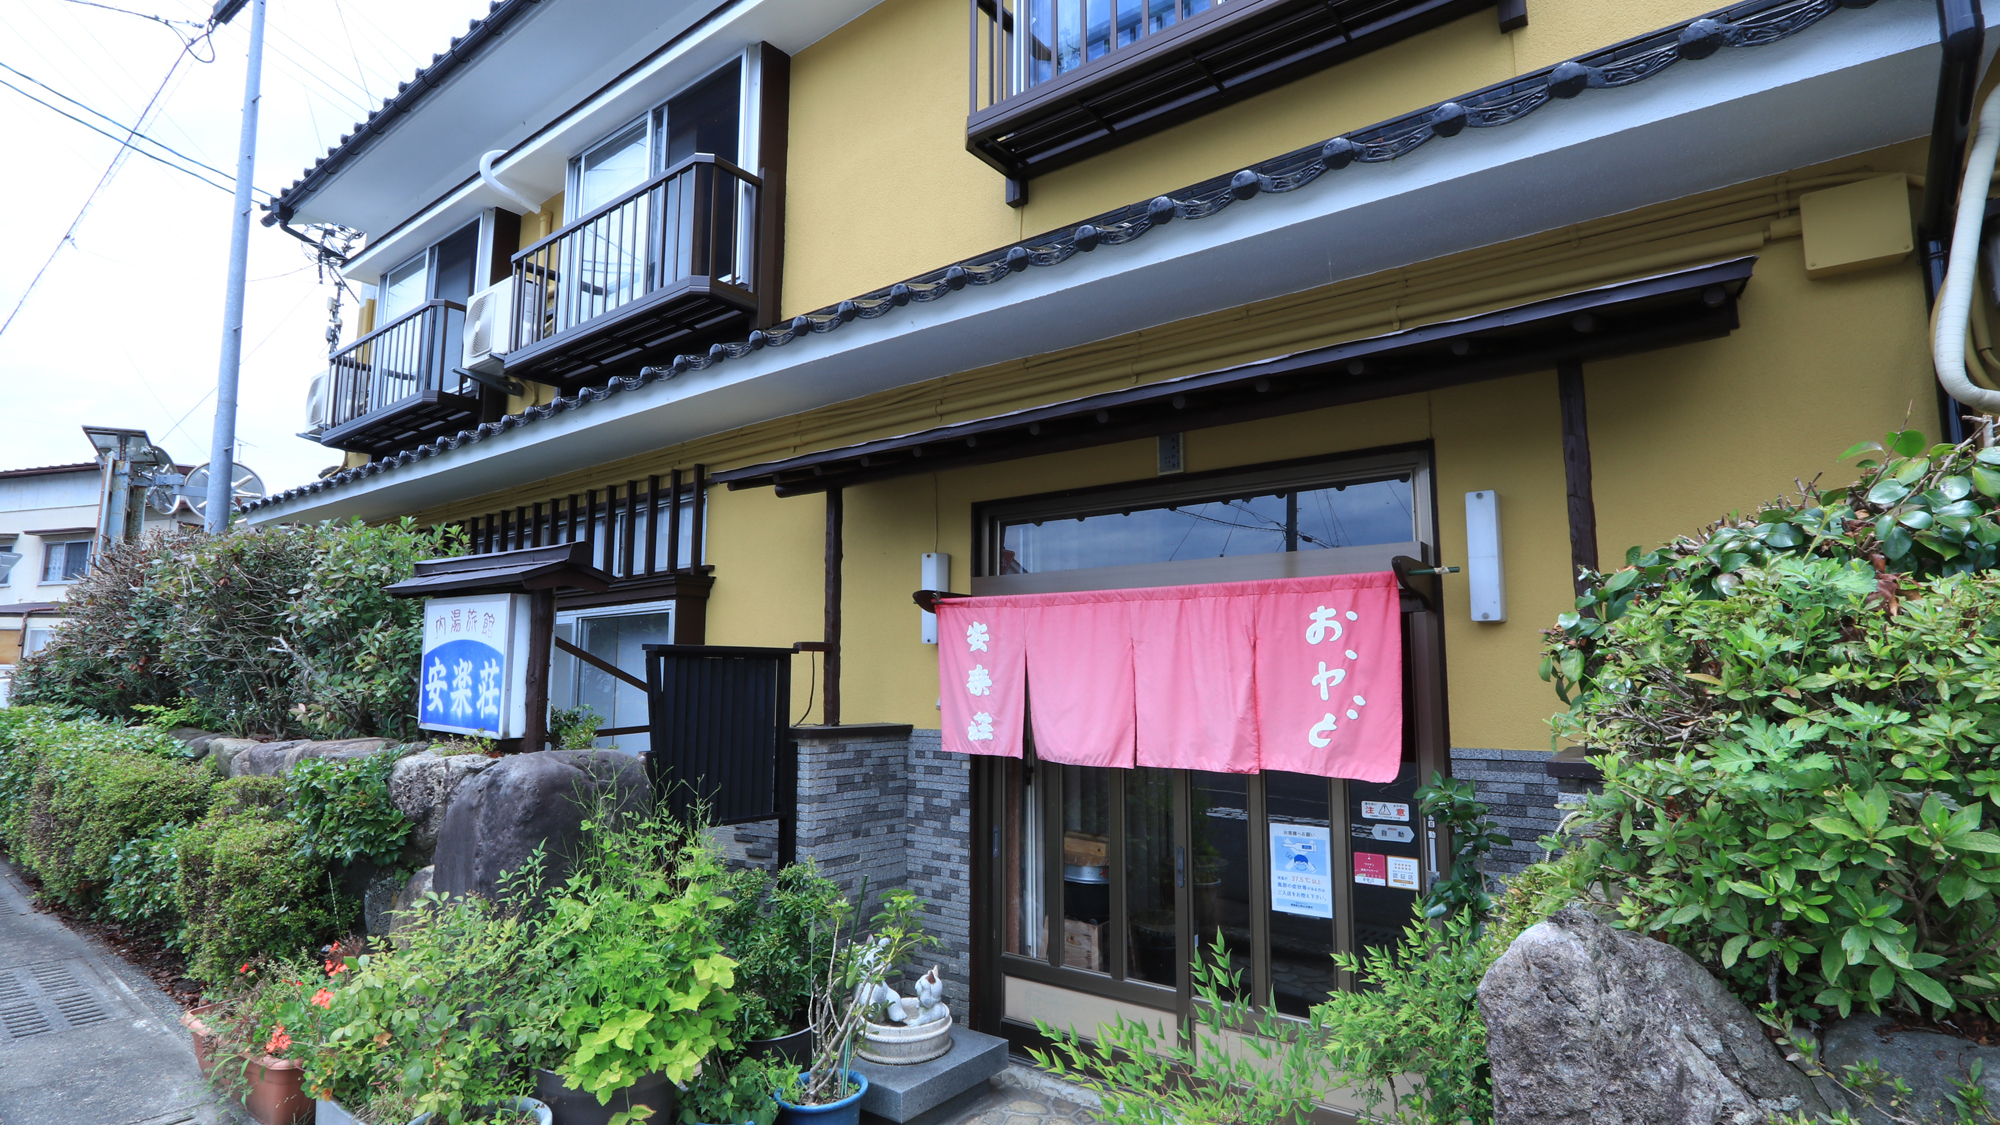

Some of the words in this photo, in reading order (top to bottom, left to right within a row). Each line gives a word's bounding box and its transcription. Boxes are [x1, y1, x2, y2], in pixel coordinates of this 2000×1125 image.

[434, 608, 495, 639] 内湯旅館
[425, 656, 500, 719] 安楽荘
